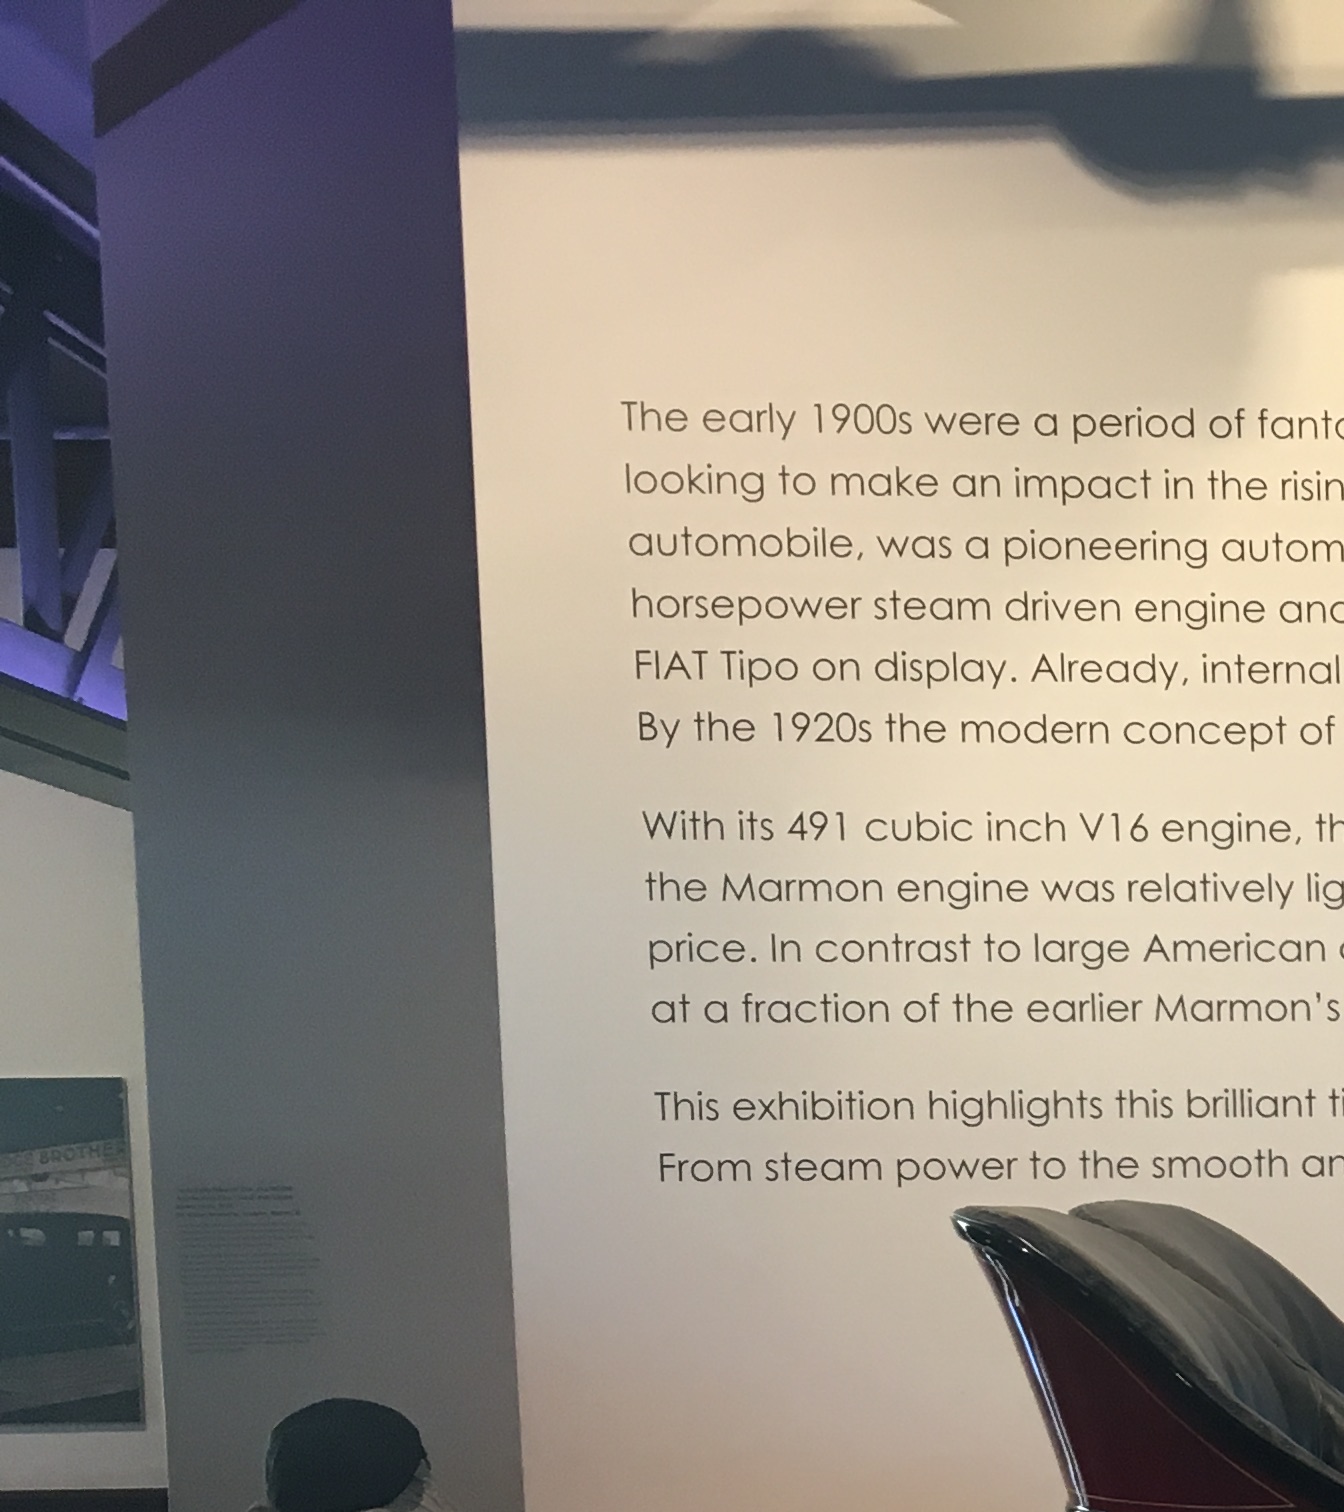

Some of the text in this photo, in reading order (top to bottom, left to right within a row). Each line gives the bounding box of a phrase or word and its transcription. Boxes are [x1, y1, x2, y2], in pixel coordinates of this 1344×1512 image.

[620, 400, 689, 433] The
[702, 401, 797, 441] early
[813, 402, 913, 435] 1900s
[923, 411, 1021, 437] were
[1033, 412, 1059, 437] a
[1072, 406, 1195, 445] period
[1208, 407, 1246, 440] of
[635, 649, 709, 681] FIAT
[719, 649, 799, 689] Tipo
[812, 657, 861, 682] on
[874, 650, 1017, 690] display.
[1030, 651, 1189, 691] Already,
[1201, 652, 1341, 685] internal
[638, 711, 681, 749] By
[693, 710, 756, 743] the
[773, 711, 873, 744] 1920s
[884, 712, 947, 744] the
[960, 713, 1110, 745] modern
[1122, 715, 1288, 753] concept
[1299, 714, 1336, 746] of
[641, 809, 725, 841] With
[737, 809, 775, 842] its
[786, 810, 846, 842] 491
[865, 810, 974, 843] cubic
[986, 810, 1066, 843] inch
[1078, 812, 1149, 843] V16
[1161, 811, 1302, 851] engine,
[659, 1152, 752, 1183] From
[764, 1151, 883, 1182] steam
[896, 1157, 1019, 1188] power
[1028, 1150, 1067, 1181] to
[1078, 1149, 1140, 1180] the
[1151, 1148, 1289, 1180] smooth
